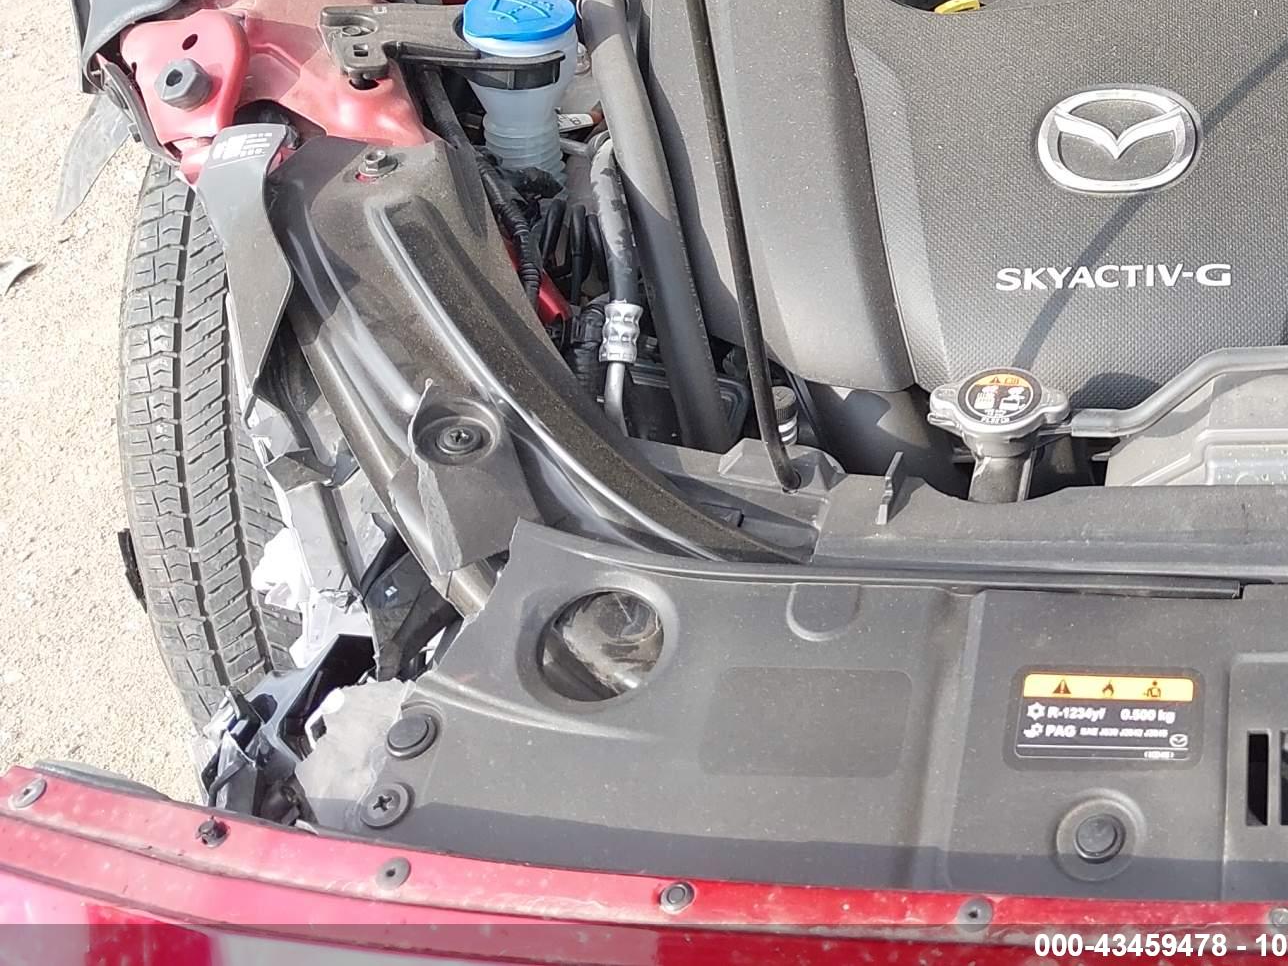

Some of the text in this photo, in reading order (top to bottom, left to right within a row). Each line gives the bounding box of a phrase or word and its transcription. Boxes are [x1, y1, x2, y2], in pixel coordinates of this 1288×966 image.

[995, 263, 1232, 291] SKYACTIV-G
[1047, 706, 1176, 724] R-1234yf 0.500 kg
[1045, 724, 1077, 737] PAG
